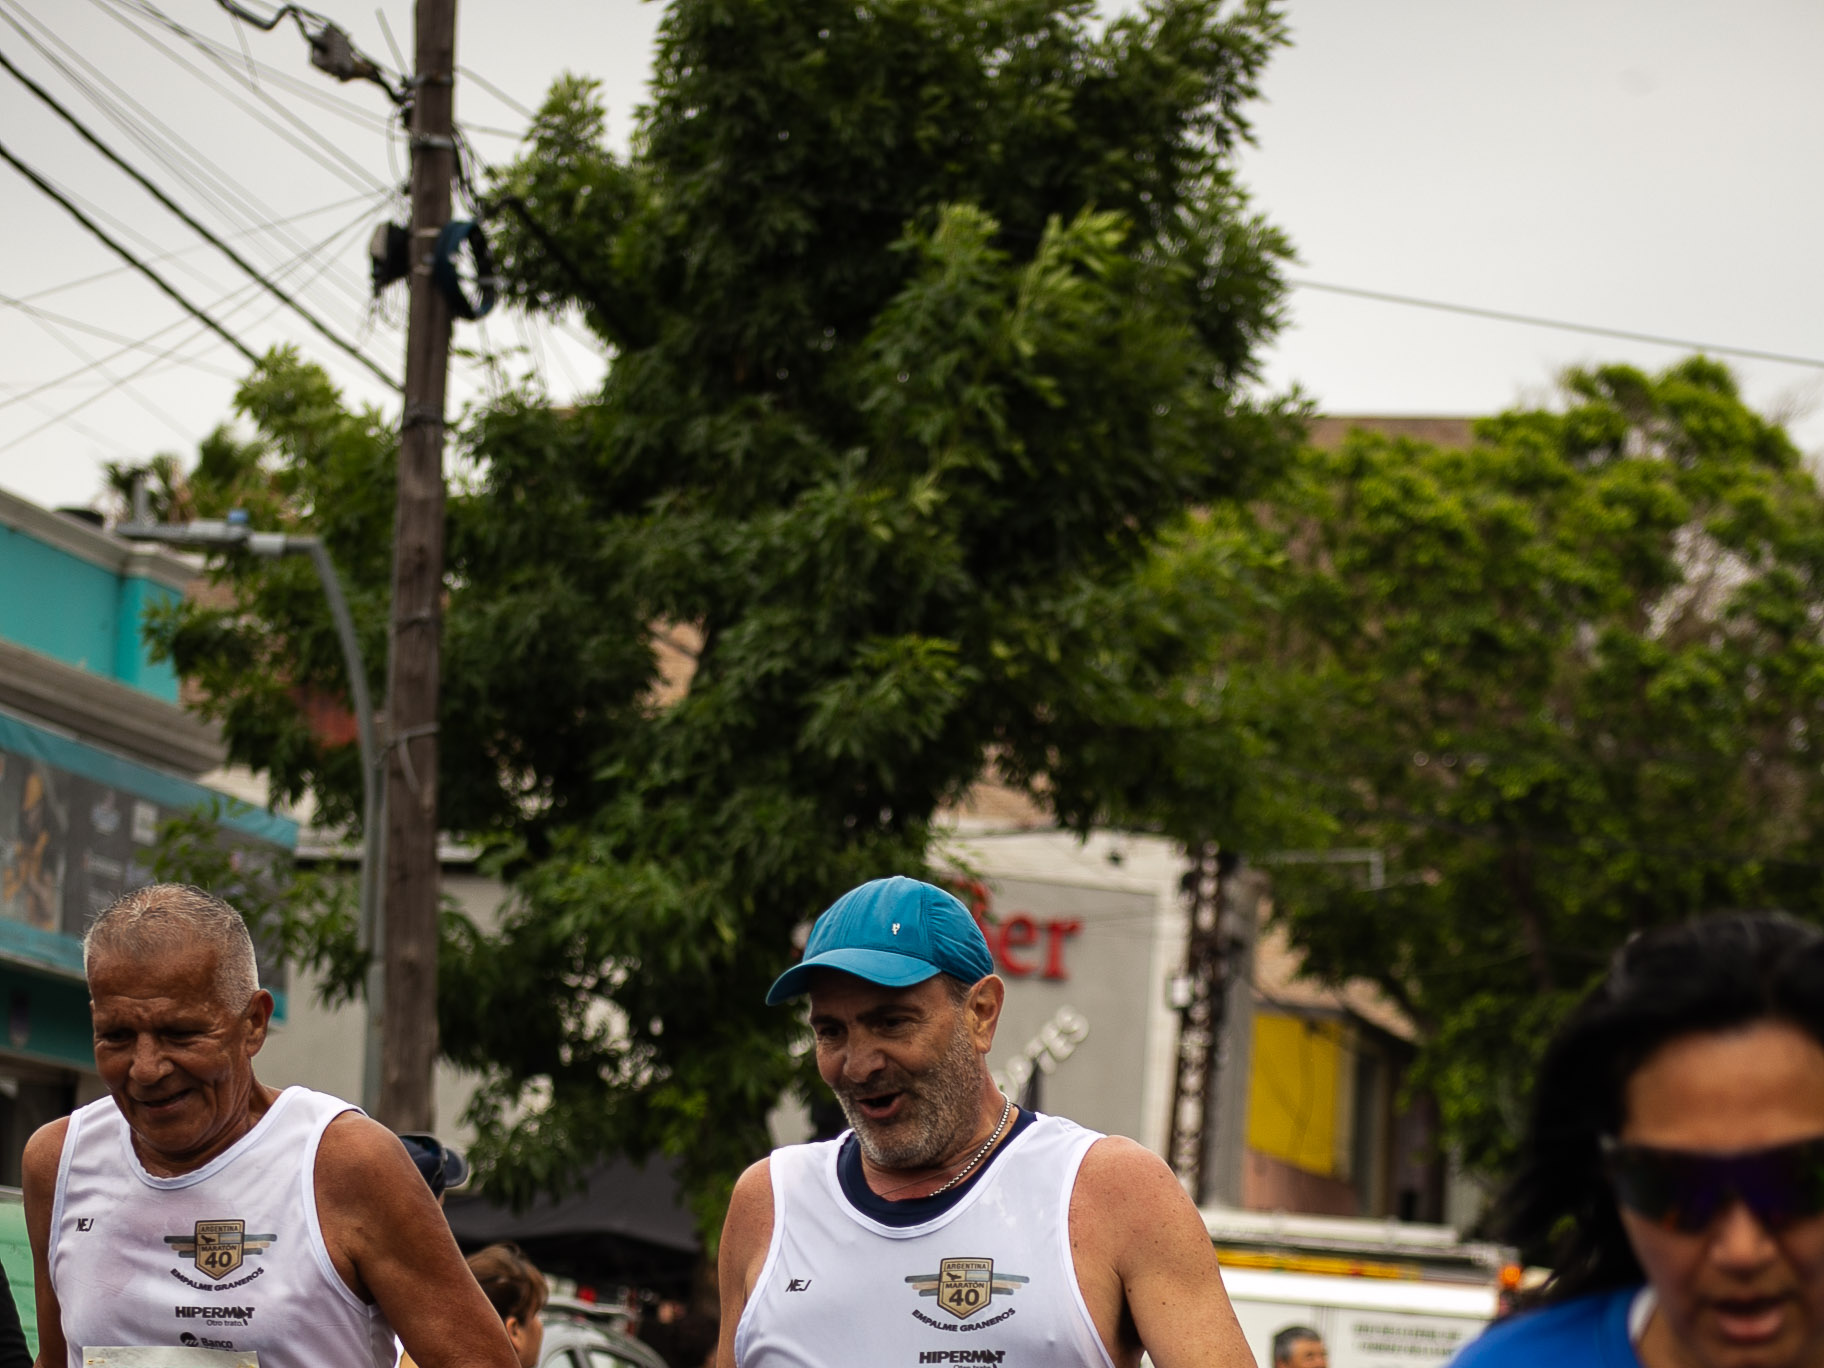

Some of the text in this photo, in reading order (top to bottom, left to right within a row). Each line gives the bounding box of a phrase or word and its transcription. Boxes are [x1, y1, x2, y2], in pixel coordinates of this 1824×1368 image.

[201, 1225, 239, 1233] ARGENTINA
[205, 1251, 232, 1268] 40
[170, 1267, 264, 1291] EMPALME GRANEROS
[945, 1281, 985, 1289] MARATÓN
[948, 1289, 980, 1306] 40
[912, 1308, 1016, 1332] EMPALME GRANEROS
[201, 1338, 233, 1348] Banco
